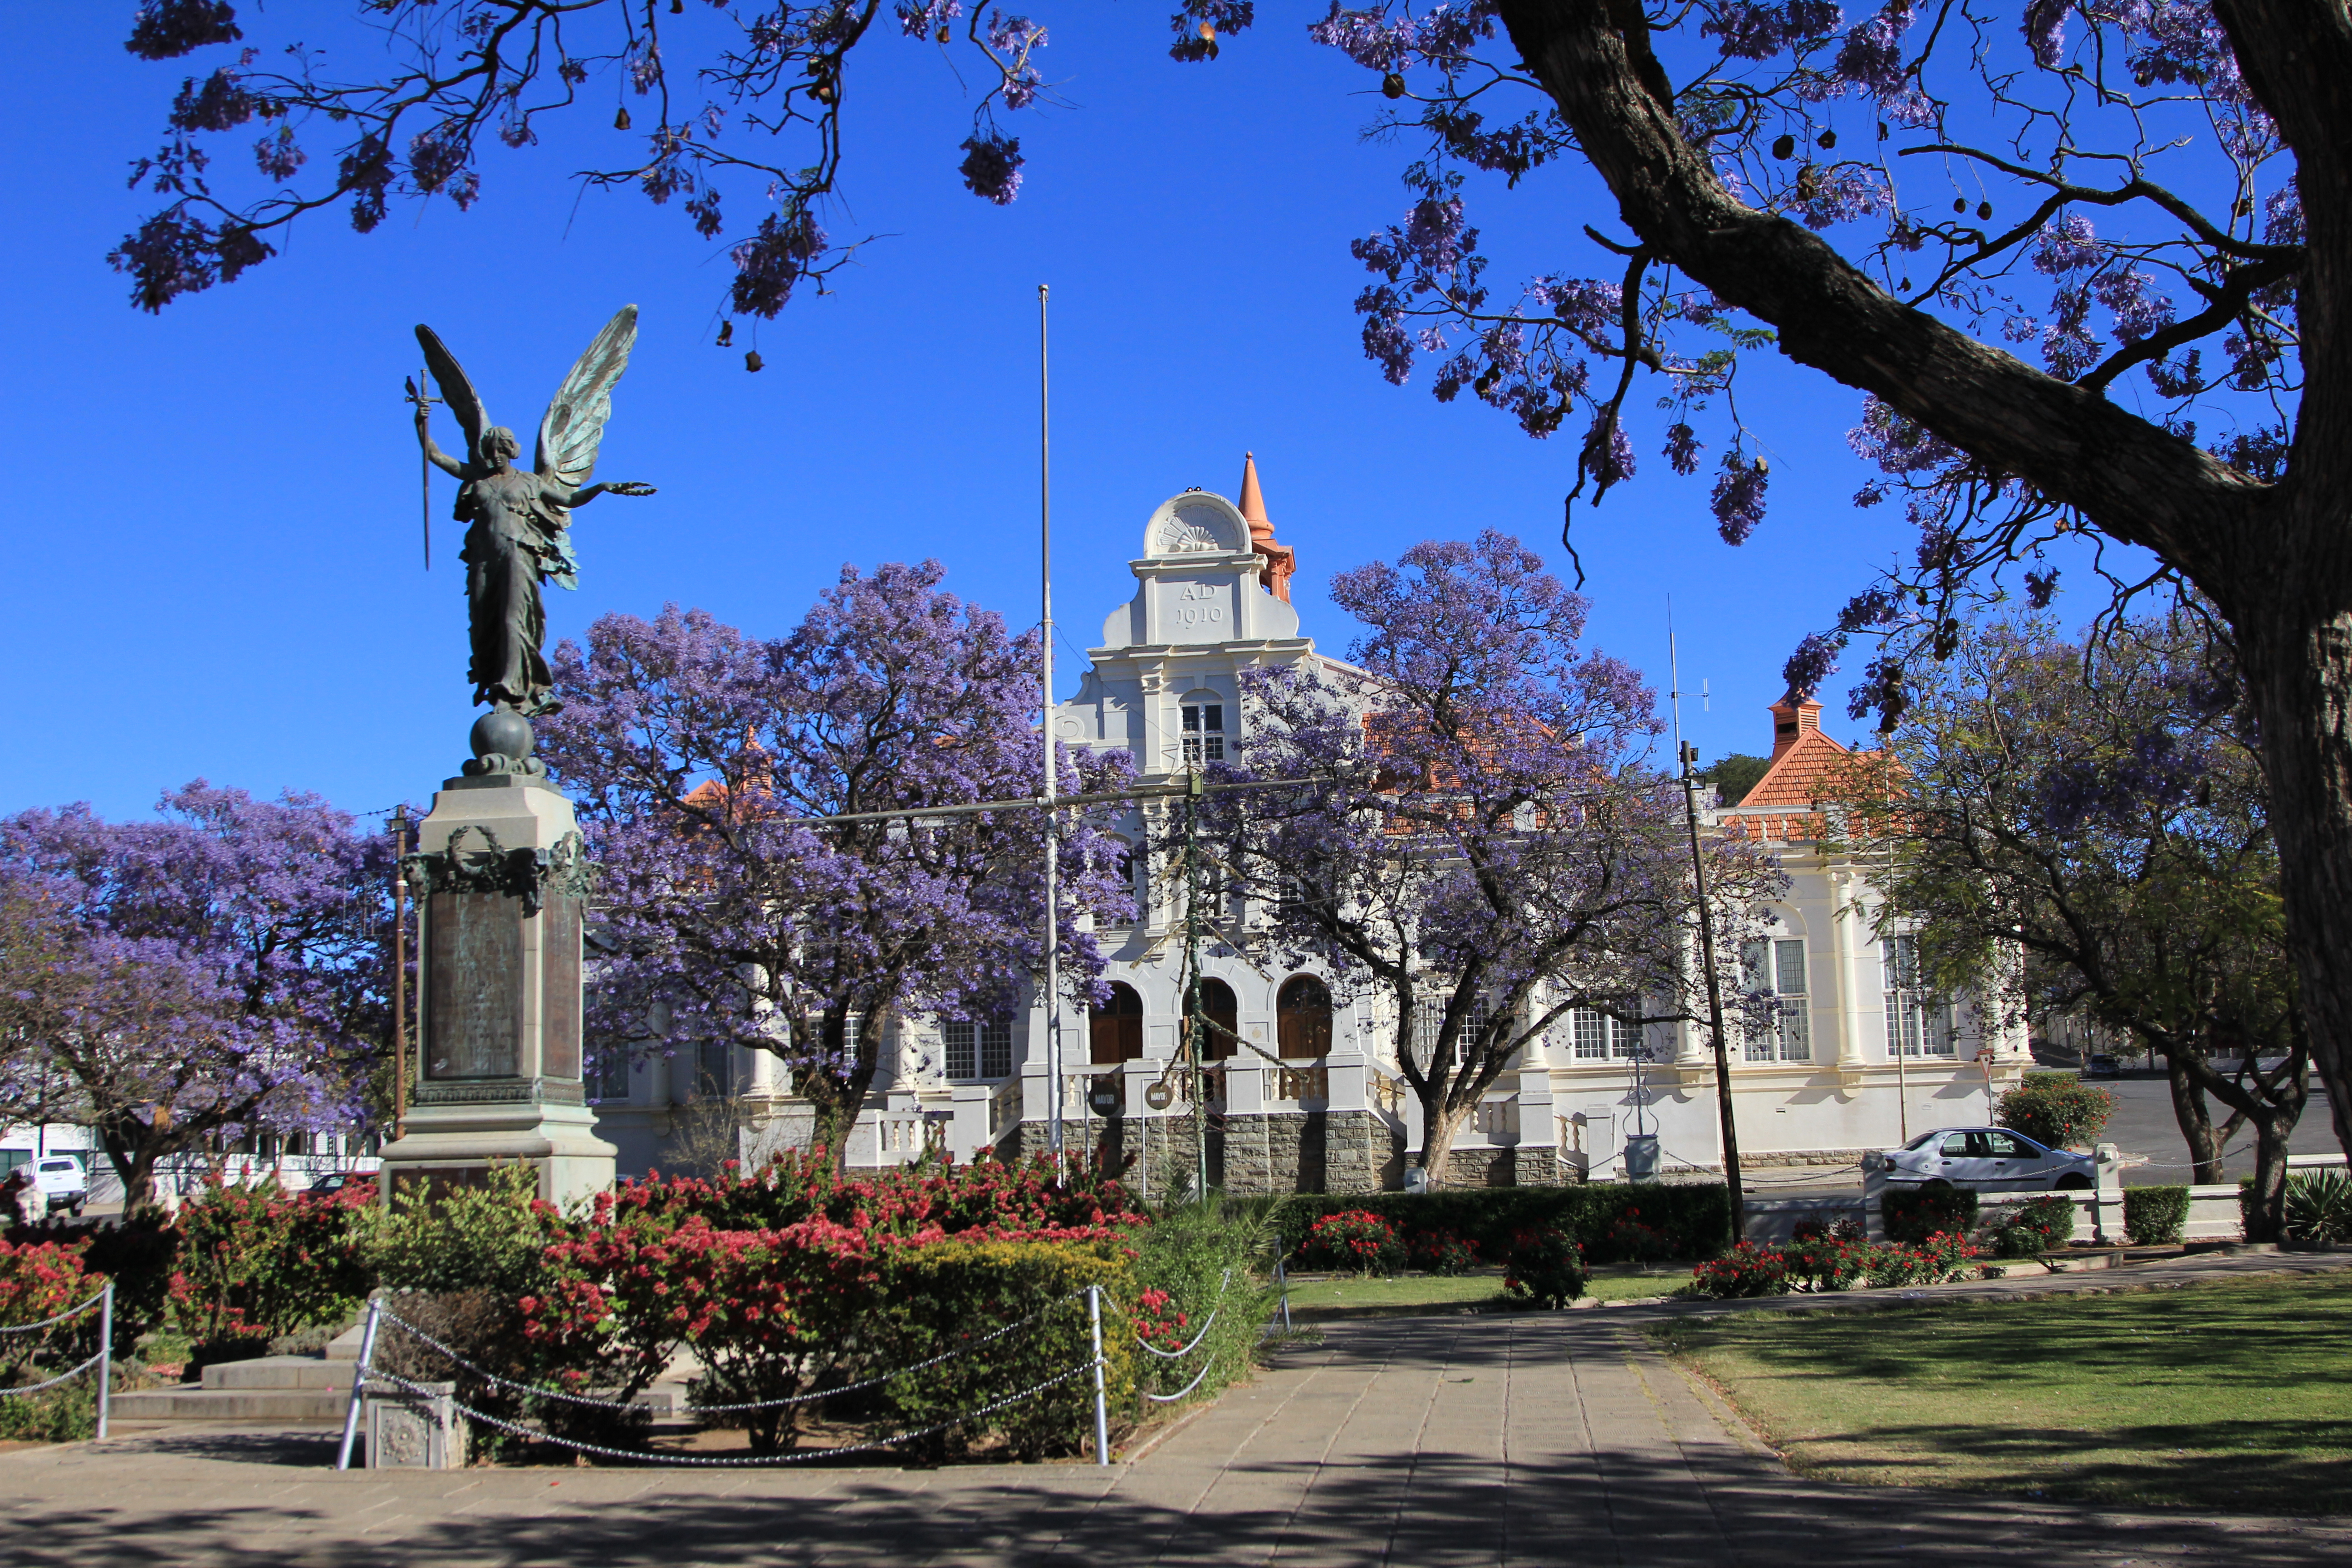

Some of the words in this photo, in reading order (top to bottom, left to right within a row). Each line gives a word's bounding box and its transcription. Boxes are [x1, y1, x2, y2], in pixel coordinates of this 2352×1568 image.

[1181, 583, 1217, 600] AD
[1176, 607, 1223, 629] 1910
[1095, 1094, 1114, 1104] MAYOR
